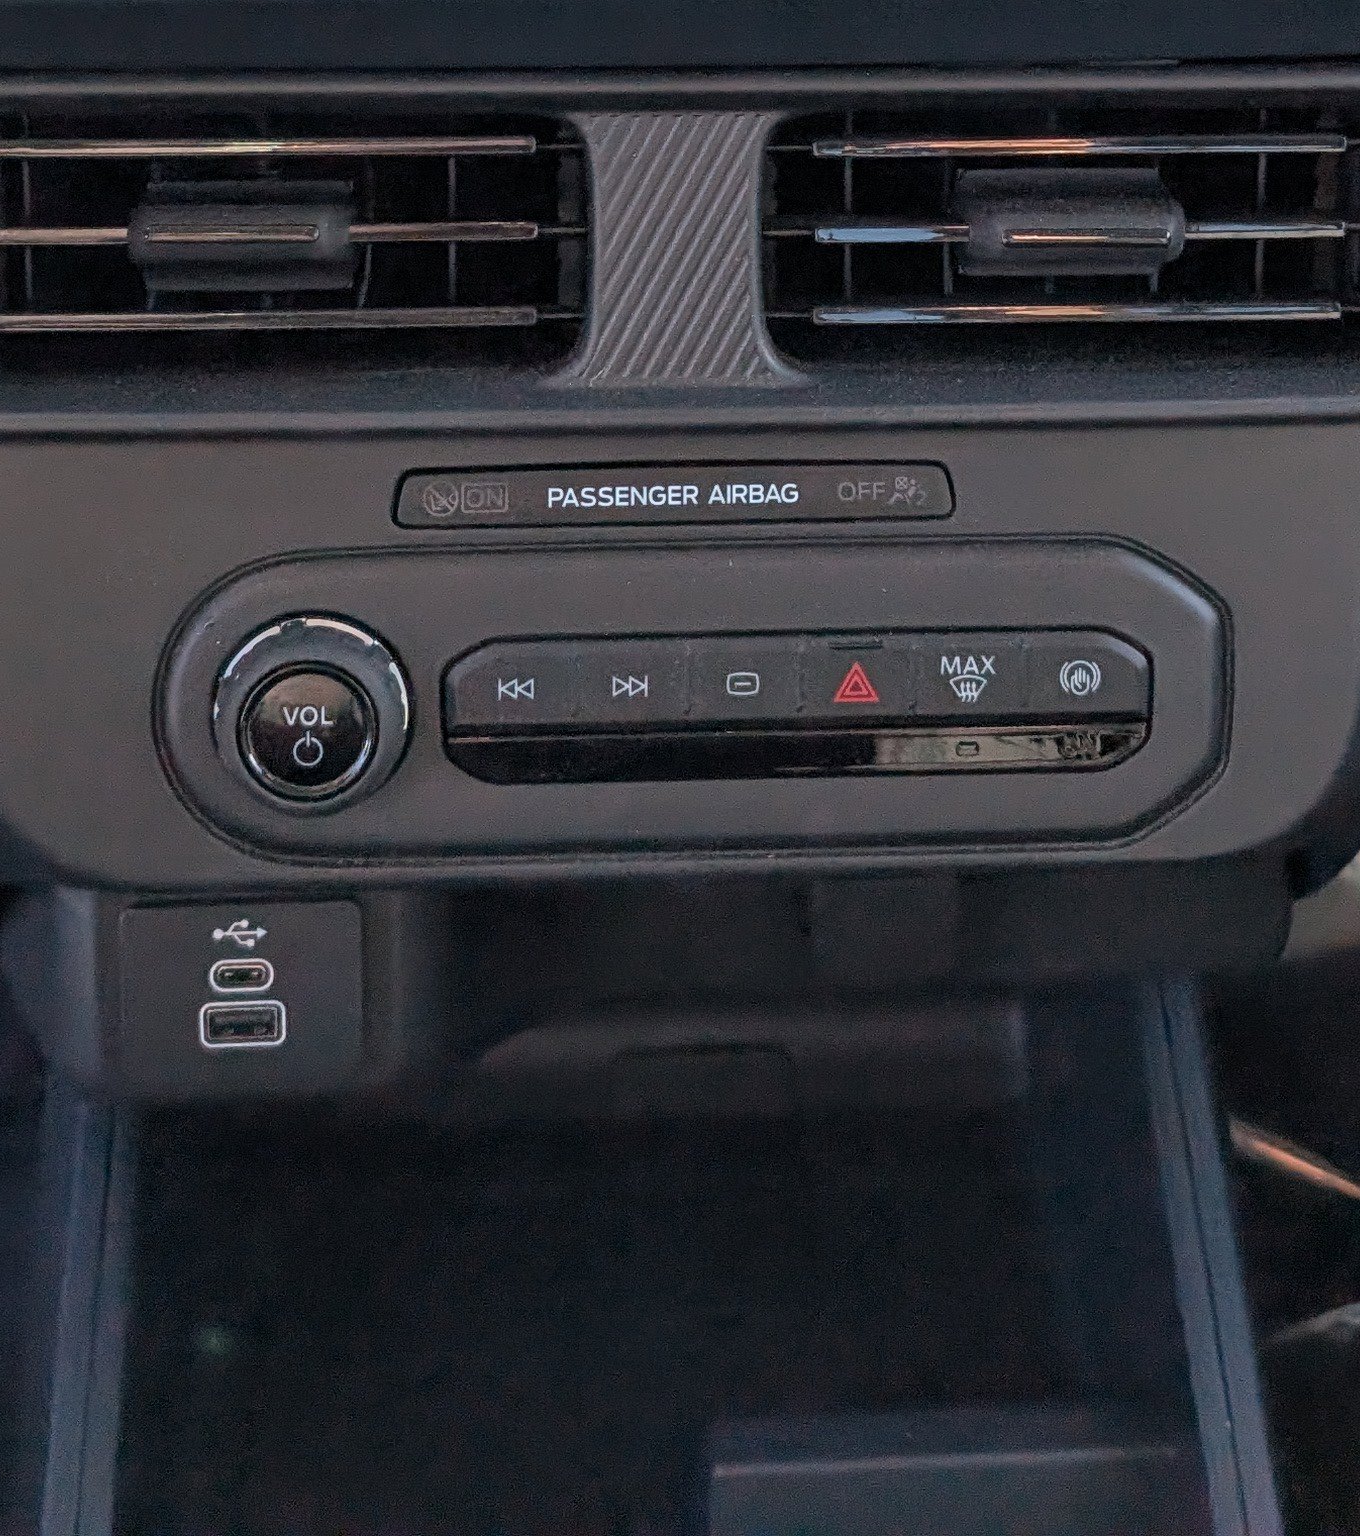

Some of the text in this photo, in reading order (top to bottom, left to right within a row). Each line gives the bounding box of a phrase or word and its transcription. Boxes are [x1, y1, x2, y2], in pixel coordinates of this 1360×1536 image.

[466, 486, 503, 508] ON
[547, 482, 799, 508] PASSENGER AIRBAG
[838, 481, 886, 502] OFF
[941, 655, 996, 675] MAX
[282, 704, 334, 728] VOL
